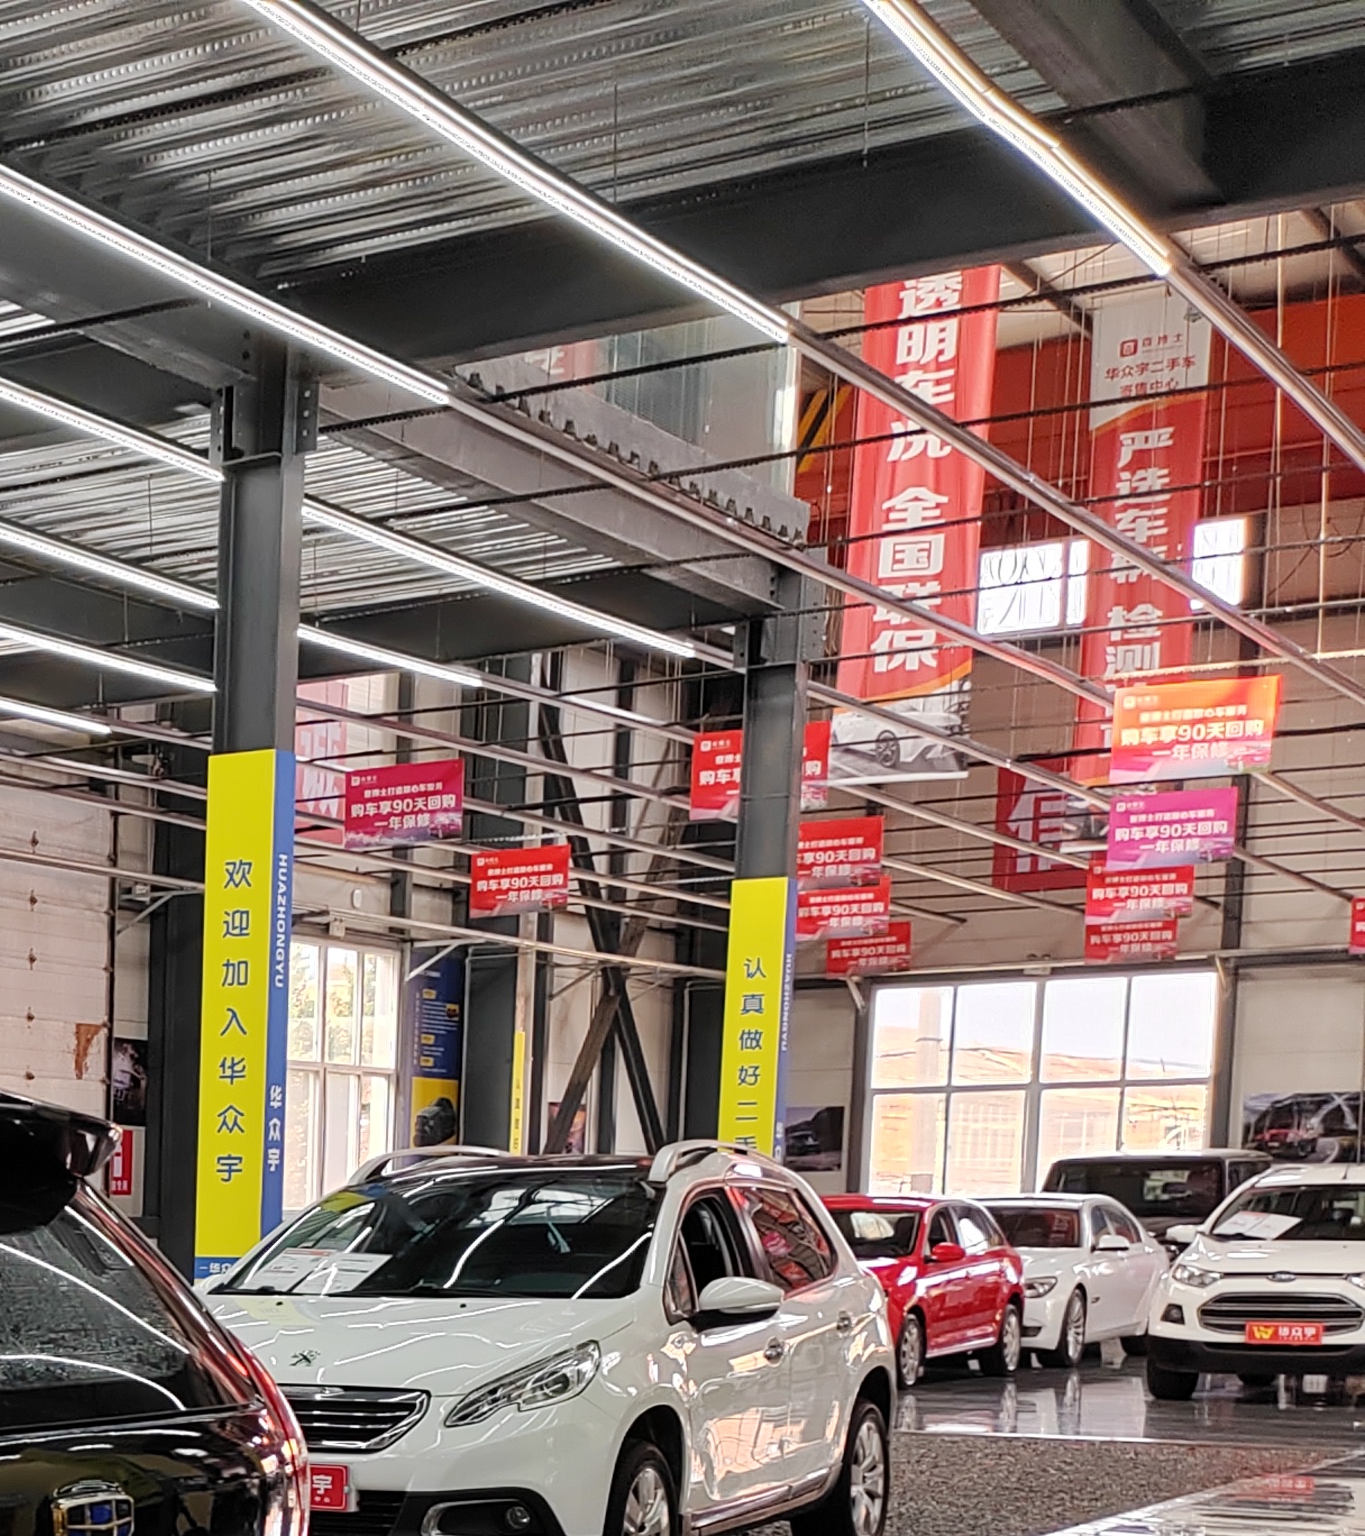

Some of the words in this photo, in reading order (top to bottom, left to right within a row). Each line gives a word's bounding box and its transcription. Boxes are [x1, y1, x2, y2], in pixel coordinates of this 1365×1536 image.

[1104, 355, 1196, 380] 华众宇二手车
[1121, 719, 1264, 746] 购车享90天回购
[351, 794, 456, 818] 购车享90天回购
[374, 813, 431, 830] 一年保修
[1115, 821, 1228, 841] 购车享90天回购
[275, 854, 289, 988] HUAZHONGYU
[216, 859, 253, 1183] 欢迎加入华众宇
[267, 1085, 283, 1172] 华众宇
